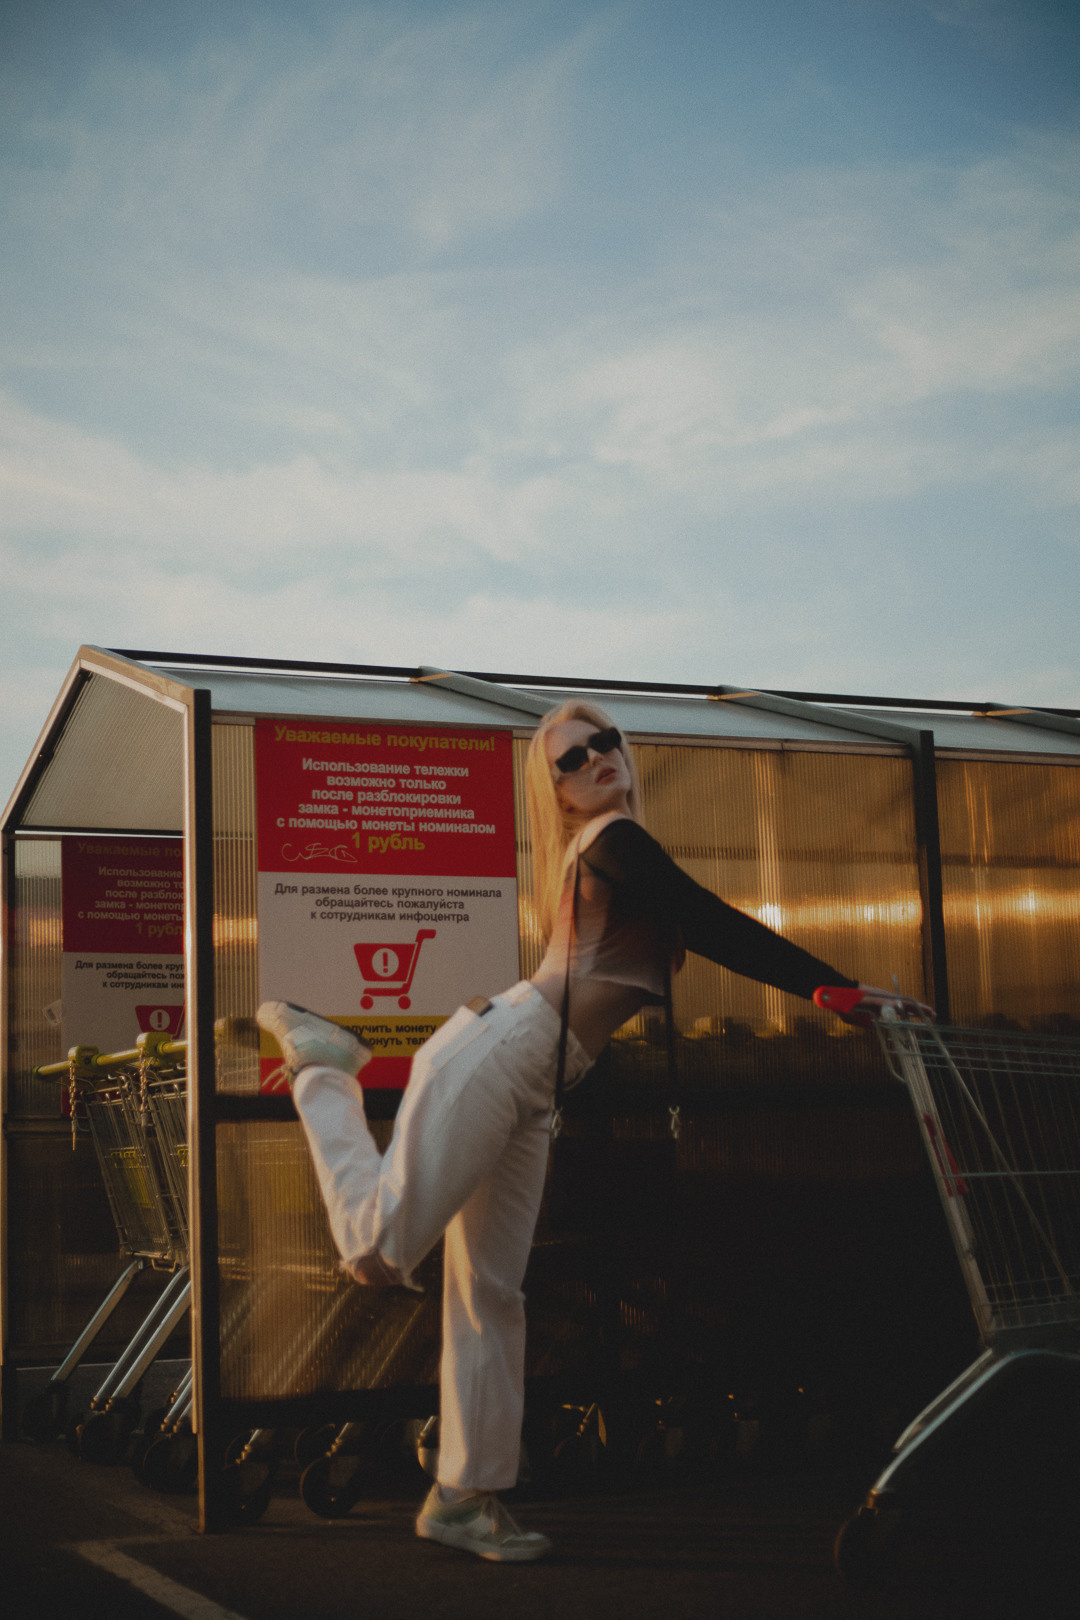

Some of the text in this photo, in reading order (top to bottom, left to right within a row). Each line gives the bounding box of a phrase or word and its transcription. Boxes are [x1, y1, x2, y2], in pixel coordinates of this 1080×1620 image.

[274, 724, 496, 752] Уважаемые покупатели!
[302, 758, 469, 777] Использование тележки
[327, 776, 447, 790] возможно только
[312, 789, 462, 805] после разблокировки
[298, 803, 339, 815] замка
[351, 805, 475, 820] монетоприемника
[276, 817, 496, 834] с помощью монеты номиналом
[351, 832, 361, 849] 1
[368, 833, 426, 853] рубль
[77, 842, 161, 858] Уважаемые
[98, 866, 183, 879] Использование
[117, 879, 171, 889] возможно
[105, 889, 137, 899] после
[274, 883, 502, 900] Для размена более крупного номинала
[95, 900, 127, 909] замка
[315, 897, 465, 913] обращайтесь пожалуйста
[87, 911, 141, 921] помощью
[310, 910, 470, 924] к сотрудникам инфоцентра
[148, 922, 184, 938] рубл
[75, 960, 94, 970] Для
[96, 961, 133, 971] размена
[136, 961, 163, 970] более
[106, 970, 167, 980] обращайтесь
[110, 980, 169, 991] сотрудникам
[395, 1025, 437, 1035] монету
